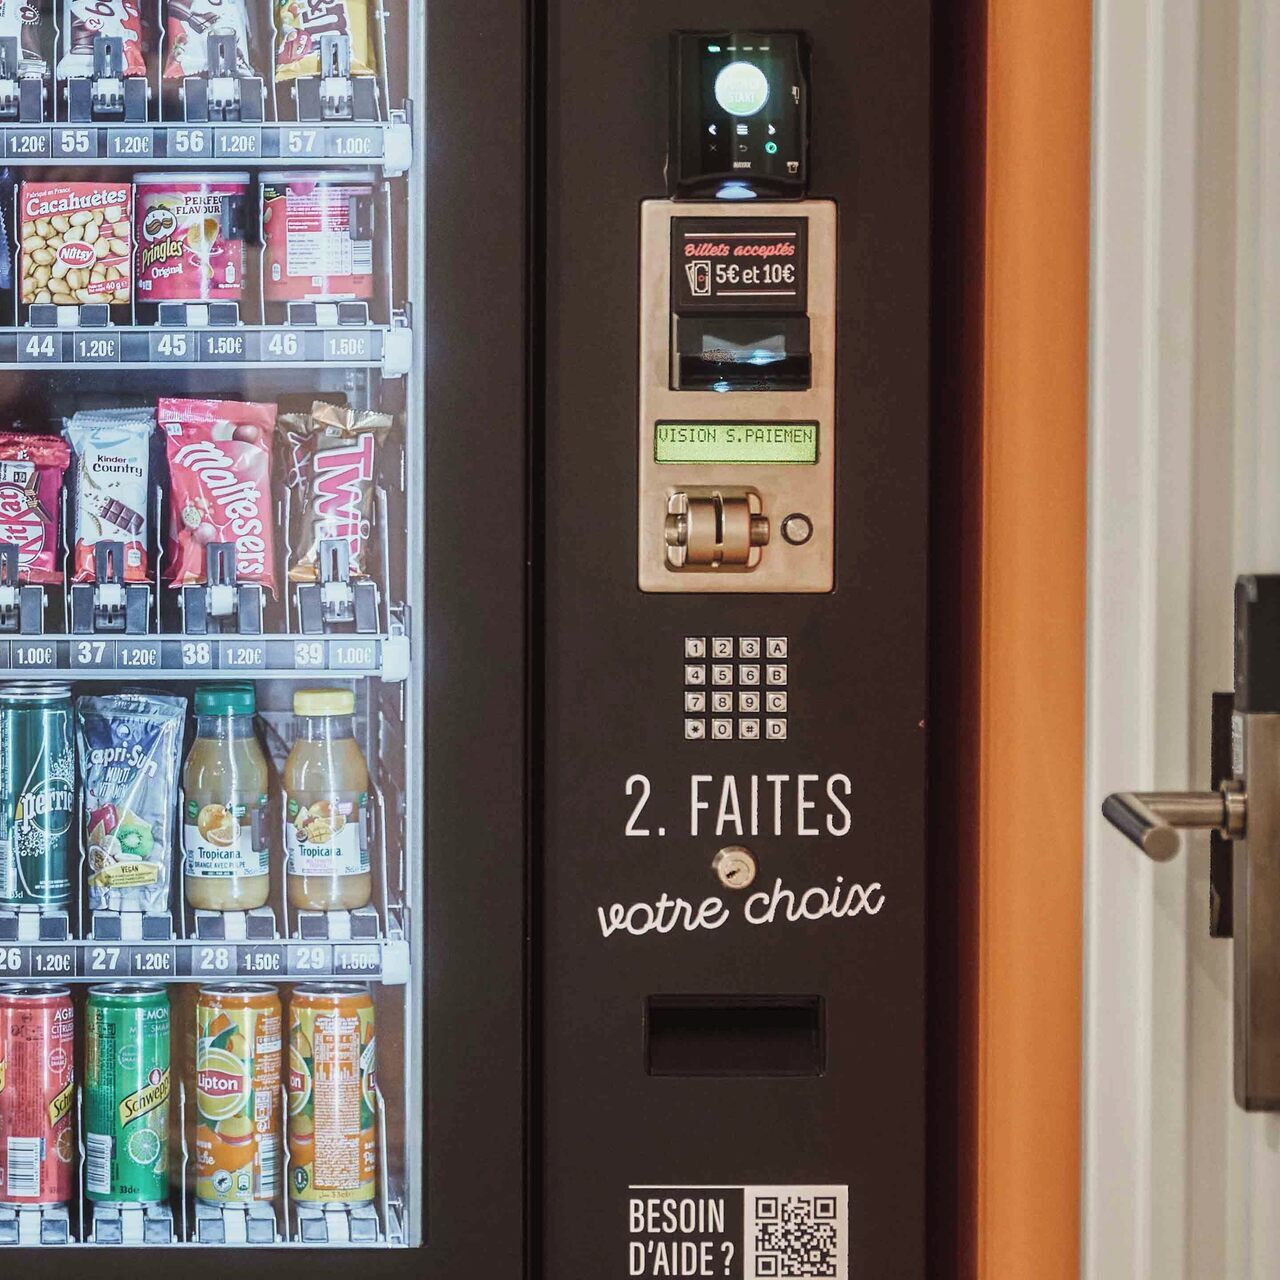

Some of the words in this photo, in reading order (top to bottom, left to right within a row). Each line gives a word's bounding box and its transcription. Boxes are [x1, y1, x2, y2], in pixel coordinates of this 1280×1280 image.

[11, 136, 46, 153] 1.20€
[26, 189, 127, 216] Cacahuètes
[142, 237, 184, 273] Pringles
[683, 242, 730, 257] Billets
[733, 242, 796, 259] acceptés
[151, 263, 184, 279] Original
[715, 264, 740, 284] 5€
[742, 265, 760, 284] et
[764, 264, 795, 284] 10€
[26, 336, 55, 357] 44
[79, 340, 115, 357] 1.20€
[157, 335, 187, 356] 45
[207, 337, 243, 353] 1.50€
[658, 428, 717, 443] VISION
[726, 428, 813, 443] S.PAIEMEN
[97, 454, 127, 464] Kinder
[92, 462, 143, 478] Country
[174, 440, 265, 574] Maltesers
[16, 647, 52, 664] 1.00€
[78, 641, 107, 663] 37
[121, 647, 156, 665] 1.20€
[625, 773, 666, 836] 2.
[690, 773, 852, 837] FAITES
[597, 893, 730, 938] votre
[744, 876, 886, 925] choix
[35, 954, 71, 971] 1.20€
[92, 948, 121, 971] 27
[134, 954, 170, 971] 1.20€
[197, 1075, 239, 1092] Lipton
[629, 1198, 725, 1234] BESOIN
[629, 1240, 714, 1276] D'AIDE
[720, 1240, 735, 1276] ?
